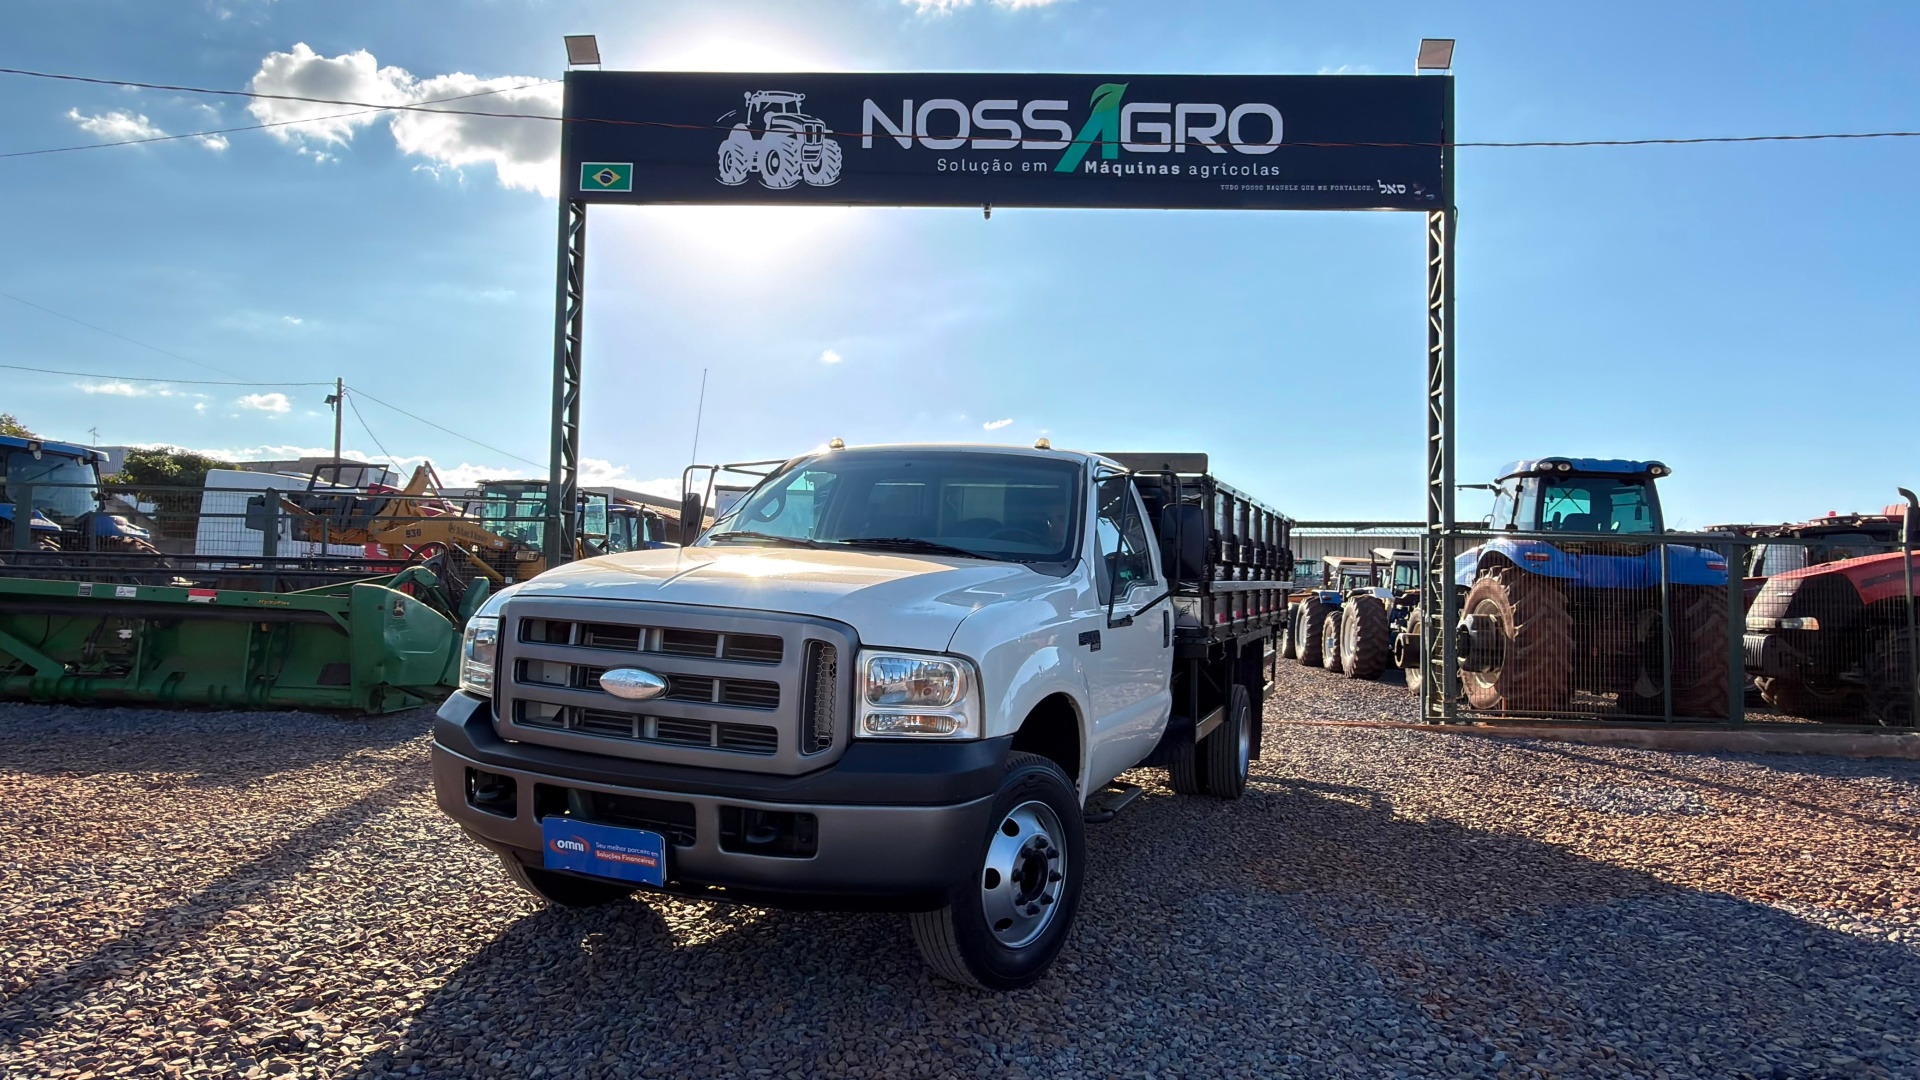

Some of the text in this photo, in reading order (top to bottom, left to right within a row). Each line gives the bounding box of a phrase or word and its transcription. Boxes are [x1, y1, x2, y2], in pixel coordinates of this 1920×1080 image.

[937, 158, 1280, 178] Solução em Máquinas agrícolas
[405, 528, 422, 538] 930
[557, 839, 584, 852] omni
[595, 841, 606, 849] Seu
[607, 843, 626, 852] melhor
[627, 847, 650, 856] parceiro
[596, 850, 621, 860] Soluções
